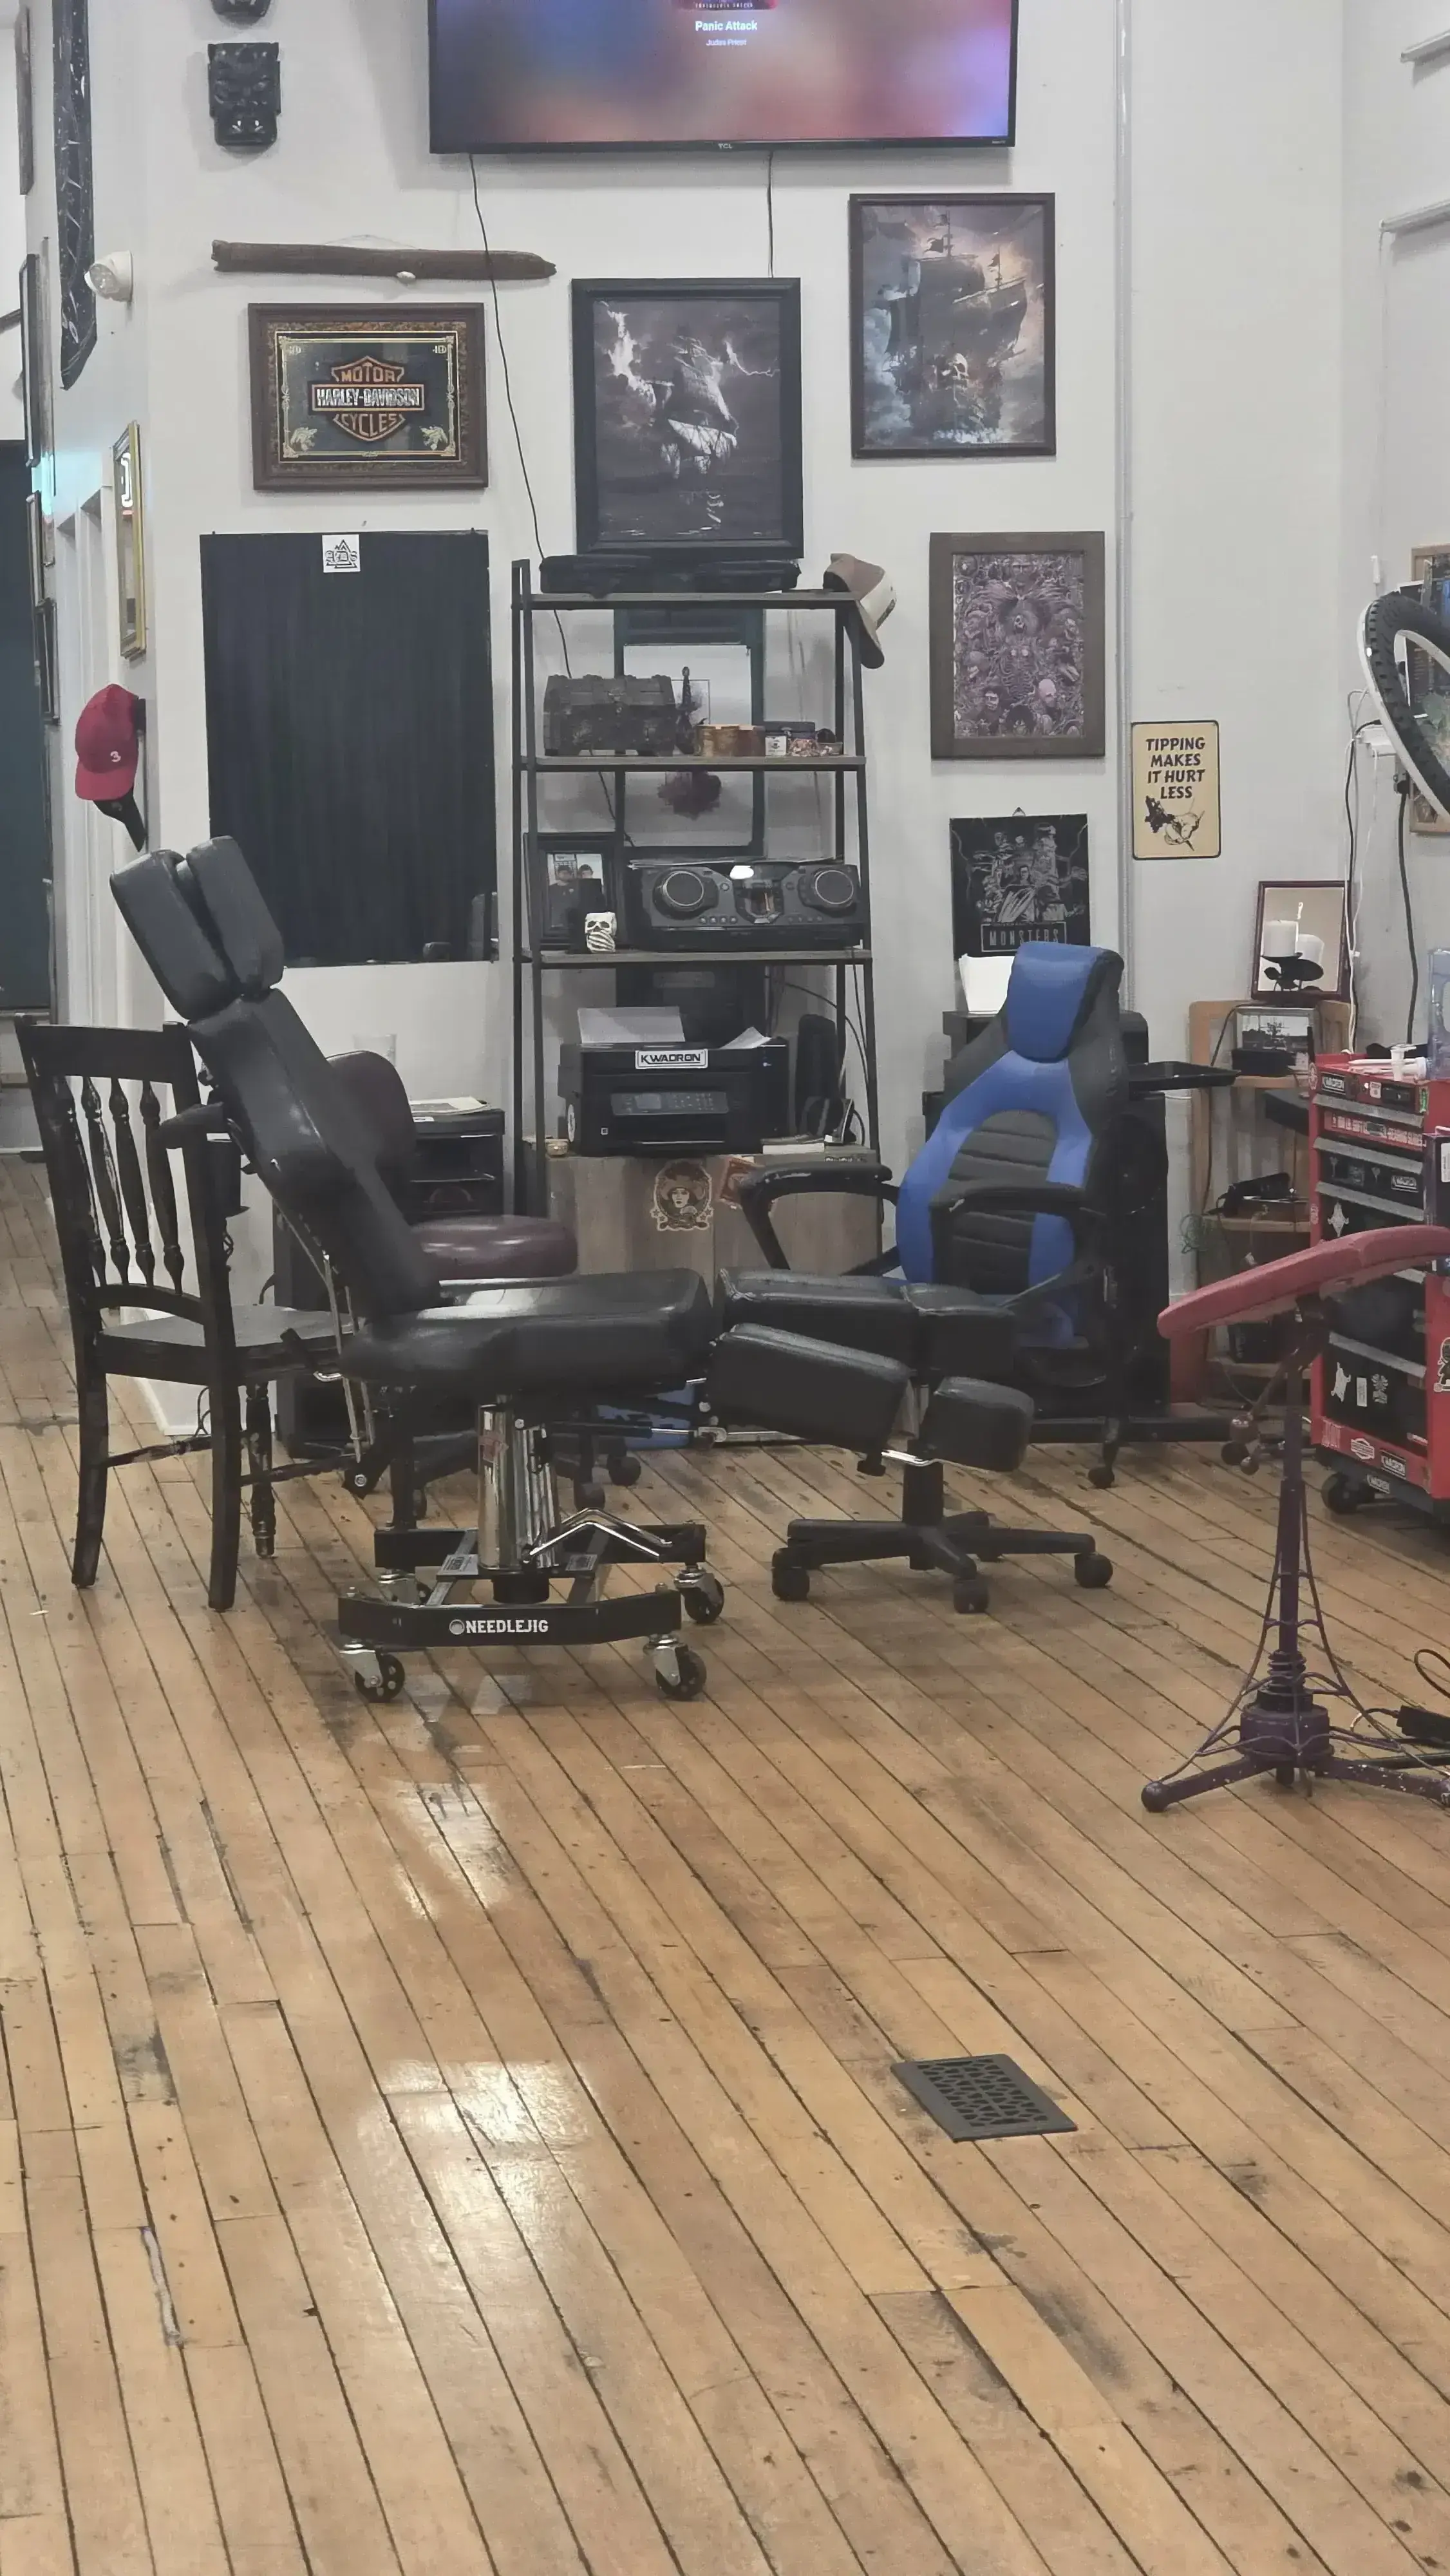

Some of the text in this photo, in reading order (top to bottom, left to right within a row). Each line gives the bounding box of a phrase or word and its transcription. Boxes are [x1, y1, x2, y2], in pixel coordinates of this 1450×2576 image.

[695, 20, 758, 31] Panic Attack
[341, 362, 395, 382] MOTOR
[316, 388, 420, 406] HARLEY-DAVIDSON
[341, 413, 397, 437] CYCLES
[1145, 737, 1206, 752] TIPPING
[110, 751, 122, 762] 3
[1151, 753, 1201, 768] MAKES
[1147, 769, 1206, 784] IT HURT
[1160, 786, 1192, 799] LESS
[989, 929, 1059, 946] MONSTERS
[641, 1054, 701, 1065] KWADRON
[466, 1619, 549, 1634] NEEDLEJIG
